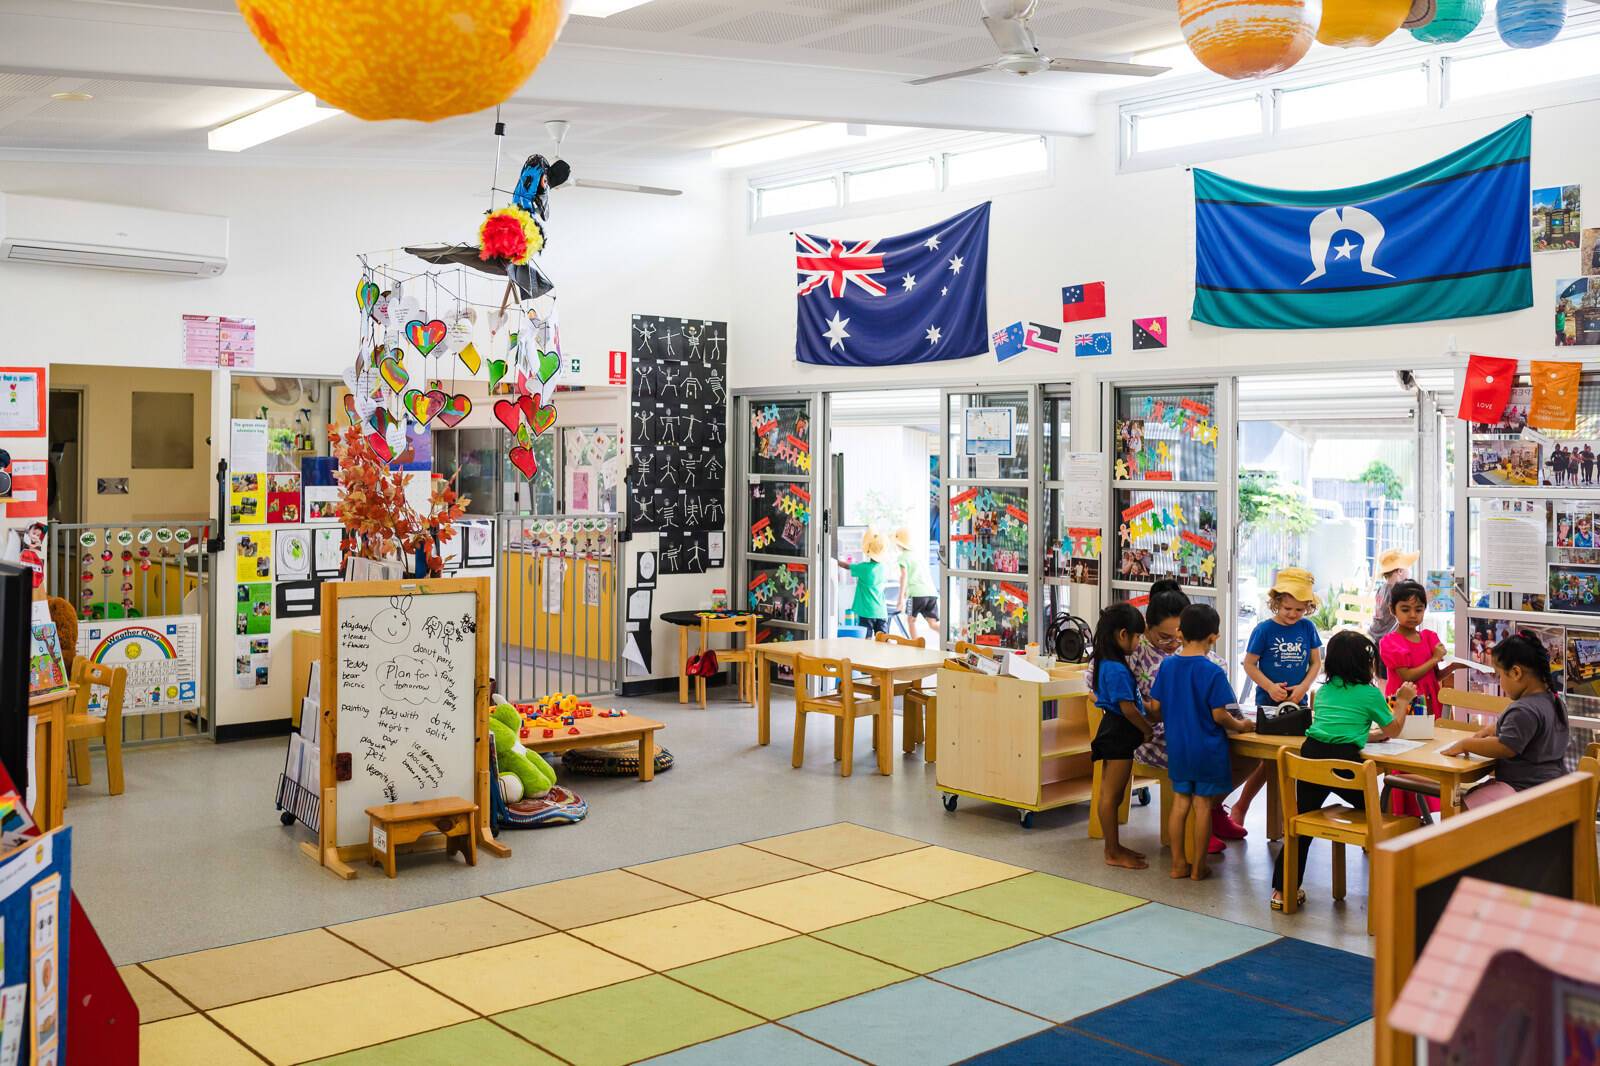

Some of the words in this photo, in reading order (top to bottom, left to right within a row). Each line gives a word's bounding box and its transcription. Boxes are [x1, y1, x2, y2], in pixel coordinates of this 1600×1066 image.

[1477, 402, 1493, 410] LOVE
[107, 630, 140, 645] Weather
[141, 629, 160, 641] Chart
[412, 643, 437, 659] donut
[1279, 642, 1302, 653] C&K
[342, 672, 361, 680] bear
[386, 665, 411, 679] Plan
[414, 670, 430, 681] for
[395, 681, 430, 690] tomorrow
[341, 703, 370, 718] painting
[380, 706, 398, 719] play
[377, 720, 389, 729] the
[441, 720, 456, 734] the
[425, 728, 448, 741] splits
[359, 736, 375, 747] play
